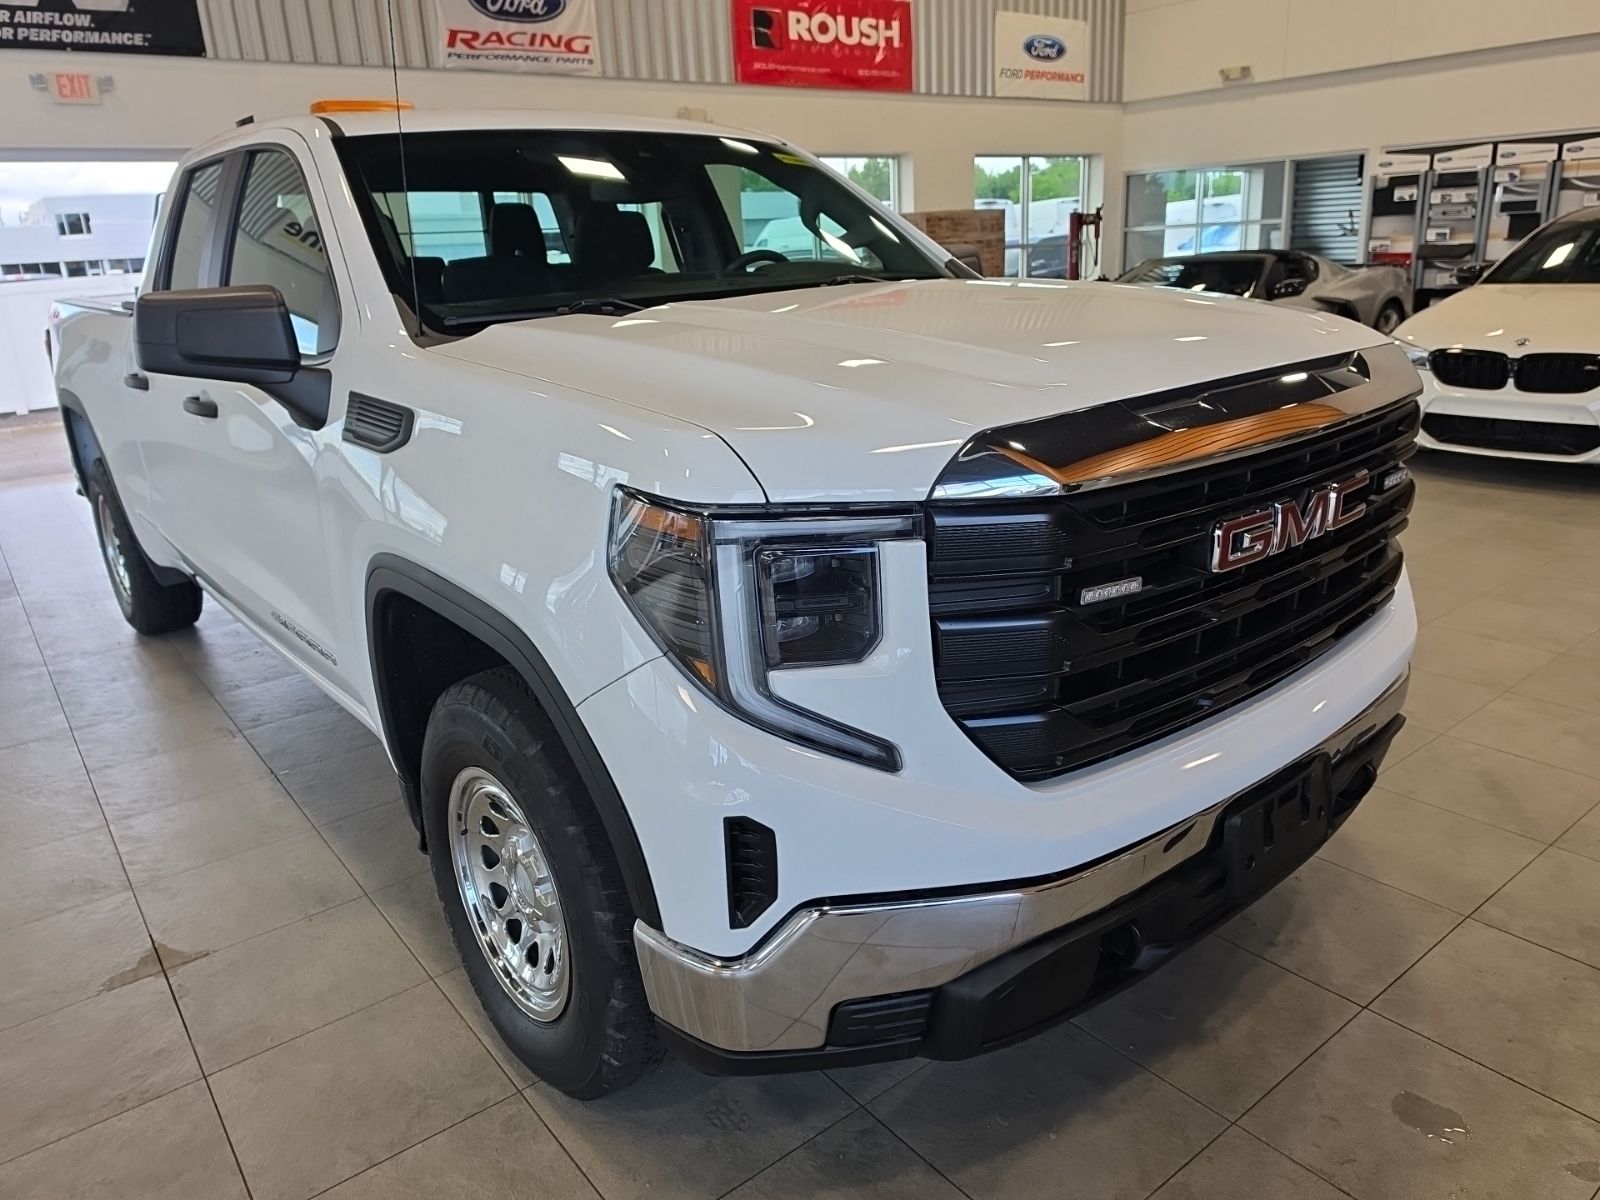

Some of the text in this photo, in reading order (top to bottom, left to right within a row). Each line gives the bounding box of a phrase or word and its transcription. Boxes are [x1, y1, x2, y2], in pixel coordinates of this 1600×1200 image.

[13, 11, 95, 27] AIRFLOW.
[787, 10, 900, 48] ROUSH
[0, 27, 14, 40] R
[447, 29, 592, 54] RACING
[1030, 38, 1060, 58] Ford
[448, 53, 594, 65] PERFORMANCE PARTS
[999, 67, 1085, 84] FORD PERFORMANCE
[55, 73, 92, 100] EXIT
[1211, 468, 1370, 573] GMC
